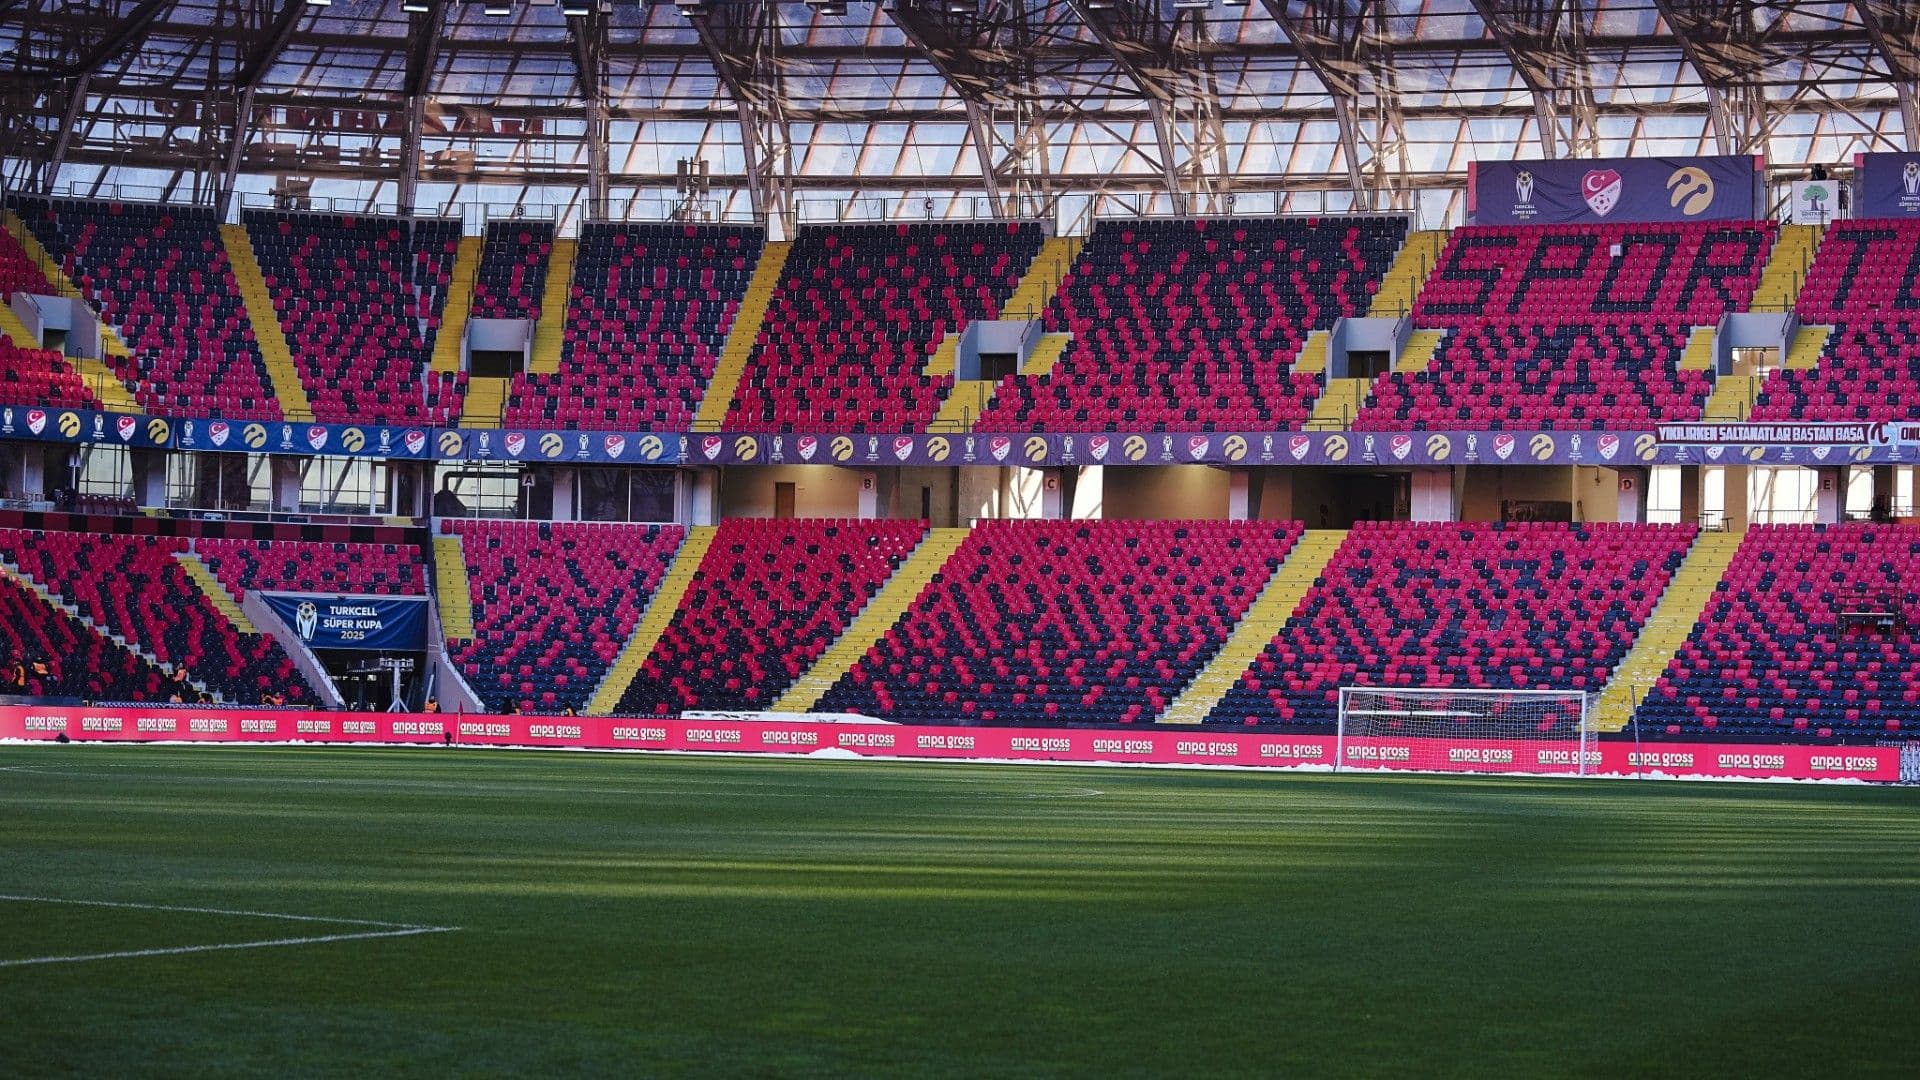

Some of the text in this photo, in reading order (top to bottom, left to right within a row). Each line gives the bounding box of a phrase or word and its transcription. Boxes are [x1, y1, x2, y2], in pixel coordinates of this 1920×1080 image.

[1719, 426, 1791, 441] SALTANATLAR
[1792, 426, 1834, 442] BAŞTAN
[525, 474, 533, 485] A
[864, 478, 872, 489] B
[1047, 478, 1055, 489] C
[1623, 478, 1633, 490] D
[1823, 478, 1832, 490] E
[329, 605, 378, 616] TURKCELL
[323, 617, 383, 630] SÜPER KUPA
[340, 630, 365, 640] 2025
[24, 716, 68, 731] anpa gross
[82, 717, 123, 731] anpa gross
[137, 718, 177, 732] anpa gross
[189, 718, 228, 732] anpa gross
[240, 719, 277, 732] anpa gross
[296, 720, 331, 733] anpa gross
[342, 721, 376, 734] anpa gross
[392, 721, 444, 735] anpa gross
[459, 722, 511, 737] anpa gross
[529, 724, 581, 738] anpa gross
[612, 727, 666, 741] anpa gross
[686, 729, 741, 743] anpa gross
[761, 730, 818, 745] anpa gross
[838, 732, 895, 747] anpa gross
[917, 735, 975, 749] anpa gross
[1011, 737, 1071, 752] anpa gross
[1092, 739, 1153, 754] anpa gross
[1176, 741, 1238, 756] anpa gross
[1260, 743, 1323, 758] anpa gross
[1346, 747, 1410, 761] anpa gross
[1448, 748, 1513, 763] anpa gross
[1537, 750, 1570, 764] anpa
[1663, 753, 1694, 767] gross
[1717, 754, 1785, 769] anpa gross
[1810, 756, 1879, 771] anpa gross
